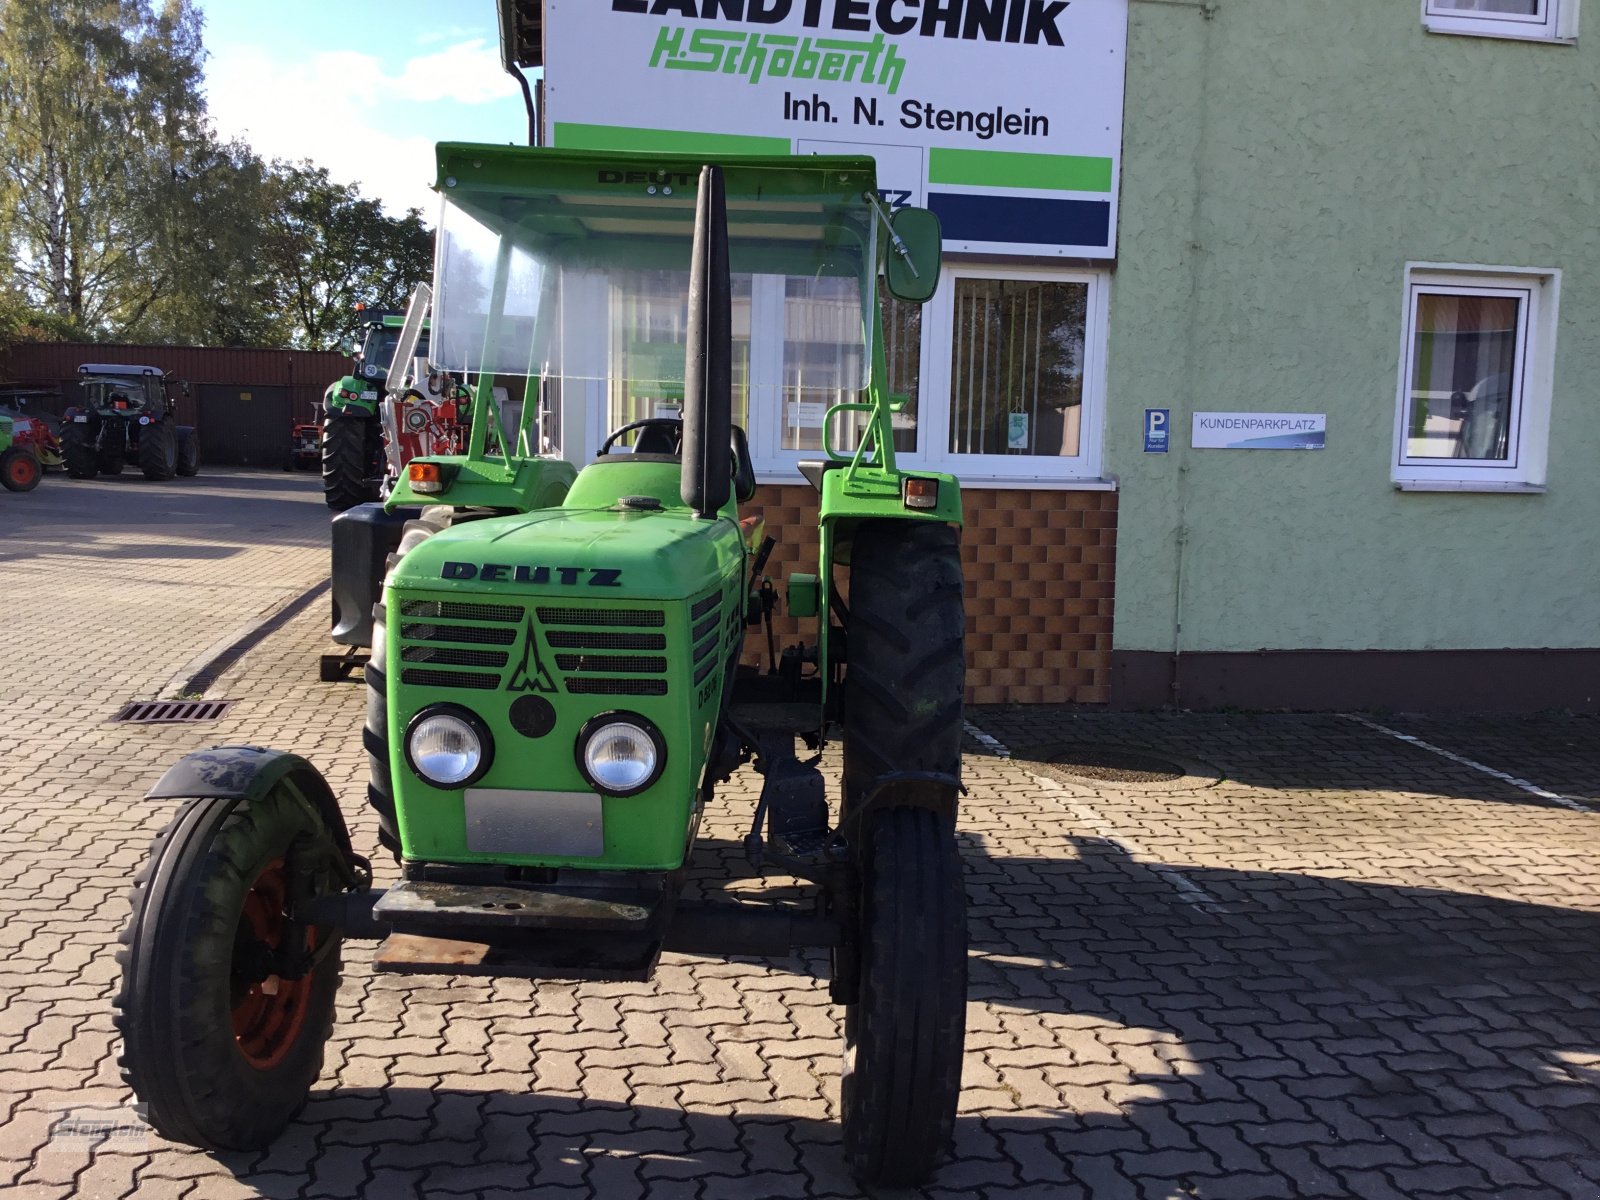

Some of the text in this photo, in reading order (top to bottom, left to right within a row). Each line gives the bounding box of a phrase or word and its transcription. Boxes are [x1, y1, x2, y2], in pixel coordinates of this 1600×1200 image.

[611, 0, 1071, 47] DTECHNIK
[783, 91, 1049, 140] Inh. N. Stenglein
[598, 170, 700, 186] DEUT
[1150, 411, 1165, 432] P
[1200, 418, 1316, 431] KUNDENPARKPLATZ
[440, 561, 622, 587] DEUTZ
